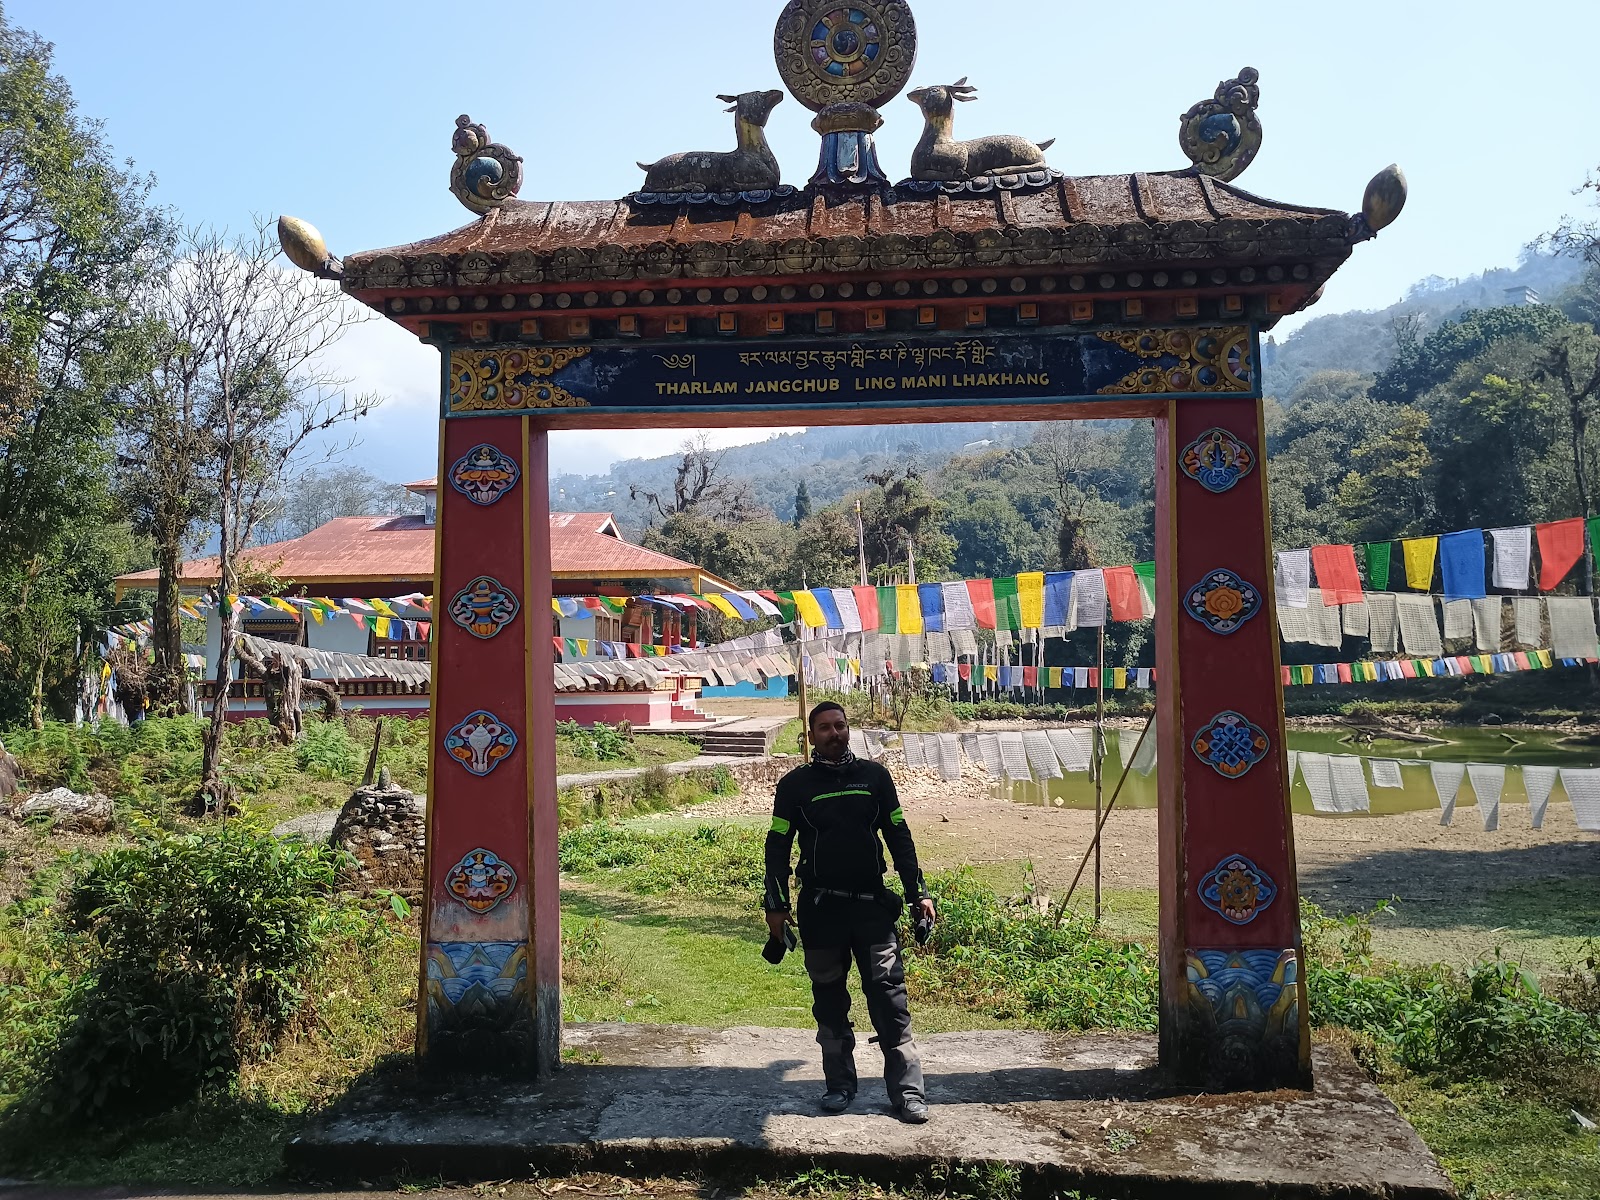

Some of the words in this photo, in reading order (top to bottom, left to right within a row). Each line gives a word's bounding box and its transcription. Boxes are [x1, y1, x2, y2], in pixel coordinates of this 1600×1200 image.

[655, 382, 738, 395] THARLAM
[744, 378, 840, 394] JANGCHUB
[855, 376, 896, 391] LING
[901, 374, 946, 389] MANI
[952, 372, 1050, 387] LHAKHANG
